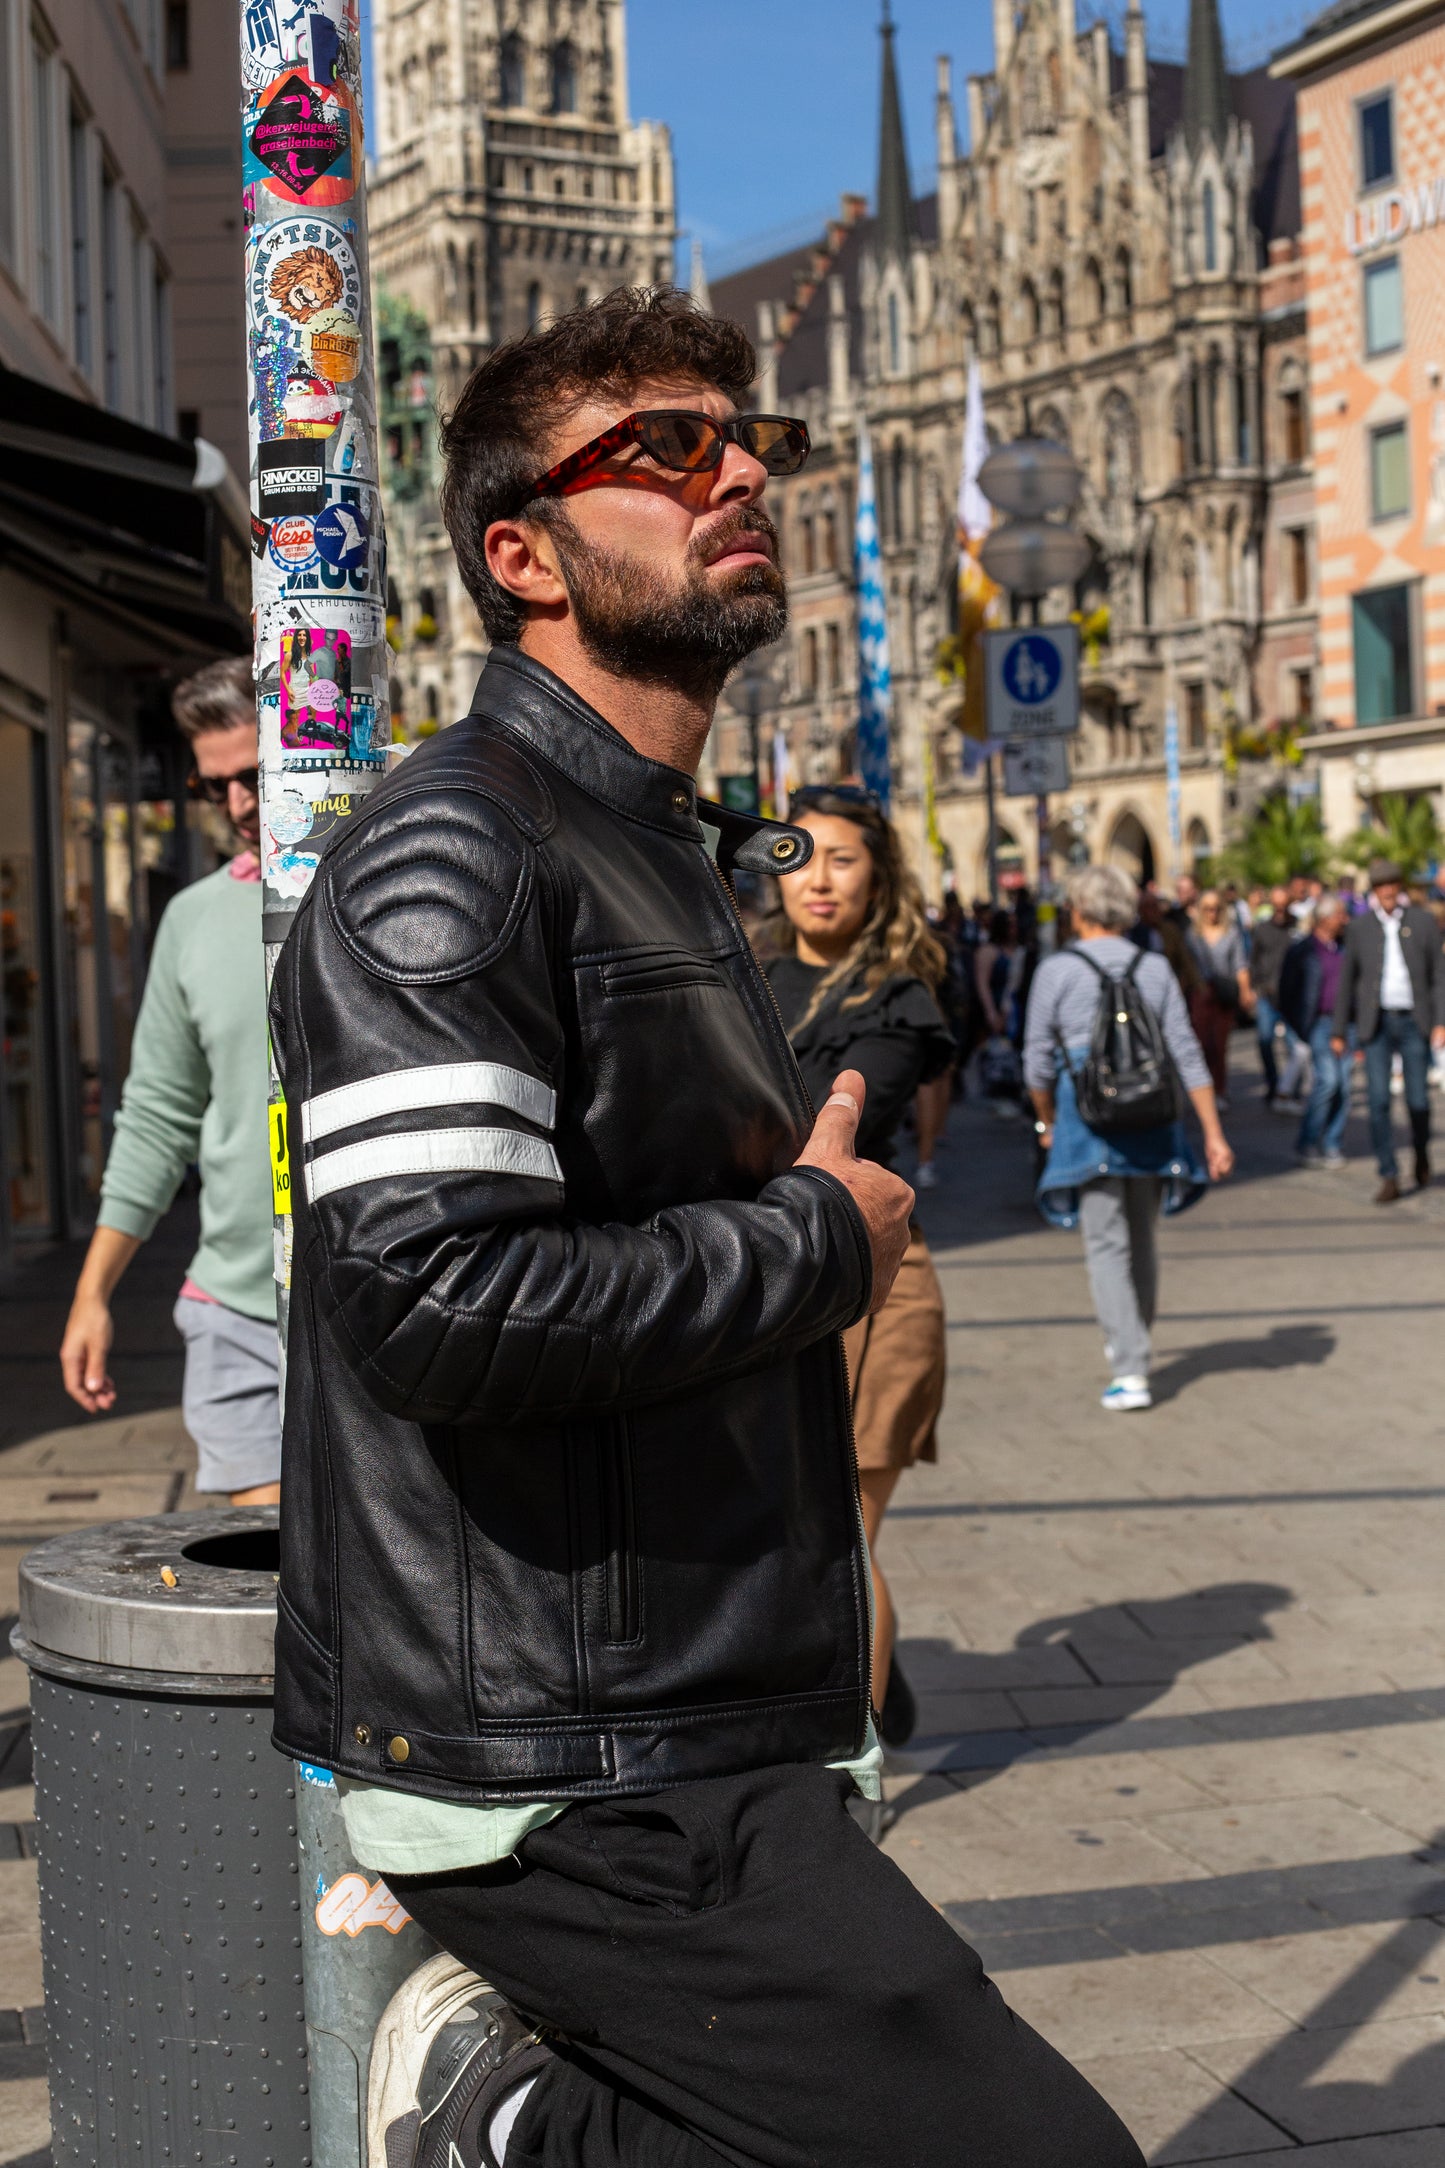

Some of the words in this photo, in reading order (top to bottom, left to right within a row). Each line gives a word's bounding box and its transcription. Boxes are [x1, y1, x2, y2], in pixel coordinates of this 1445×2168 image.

[256, 121, 338, 139] @kerwejugend
[260, 137, 337, 155] grasellenbach
[283, 224, 343, 250] TSV
[264, 486, 281, 496] DRUM
[281, 485, 295, 493] AND
[285, 521, 306, 529] CLUB
[271, 522, 314, 548] Vesp
